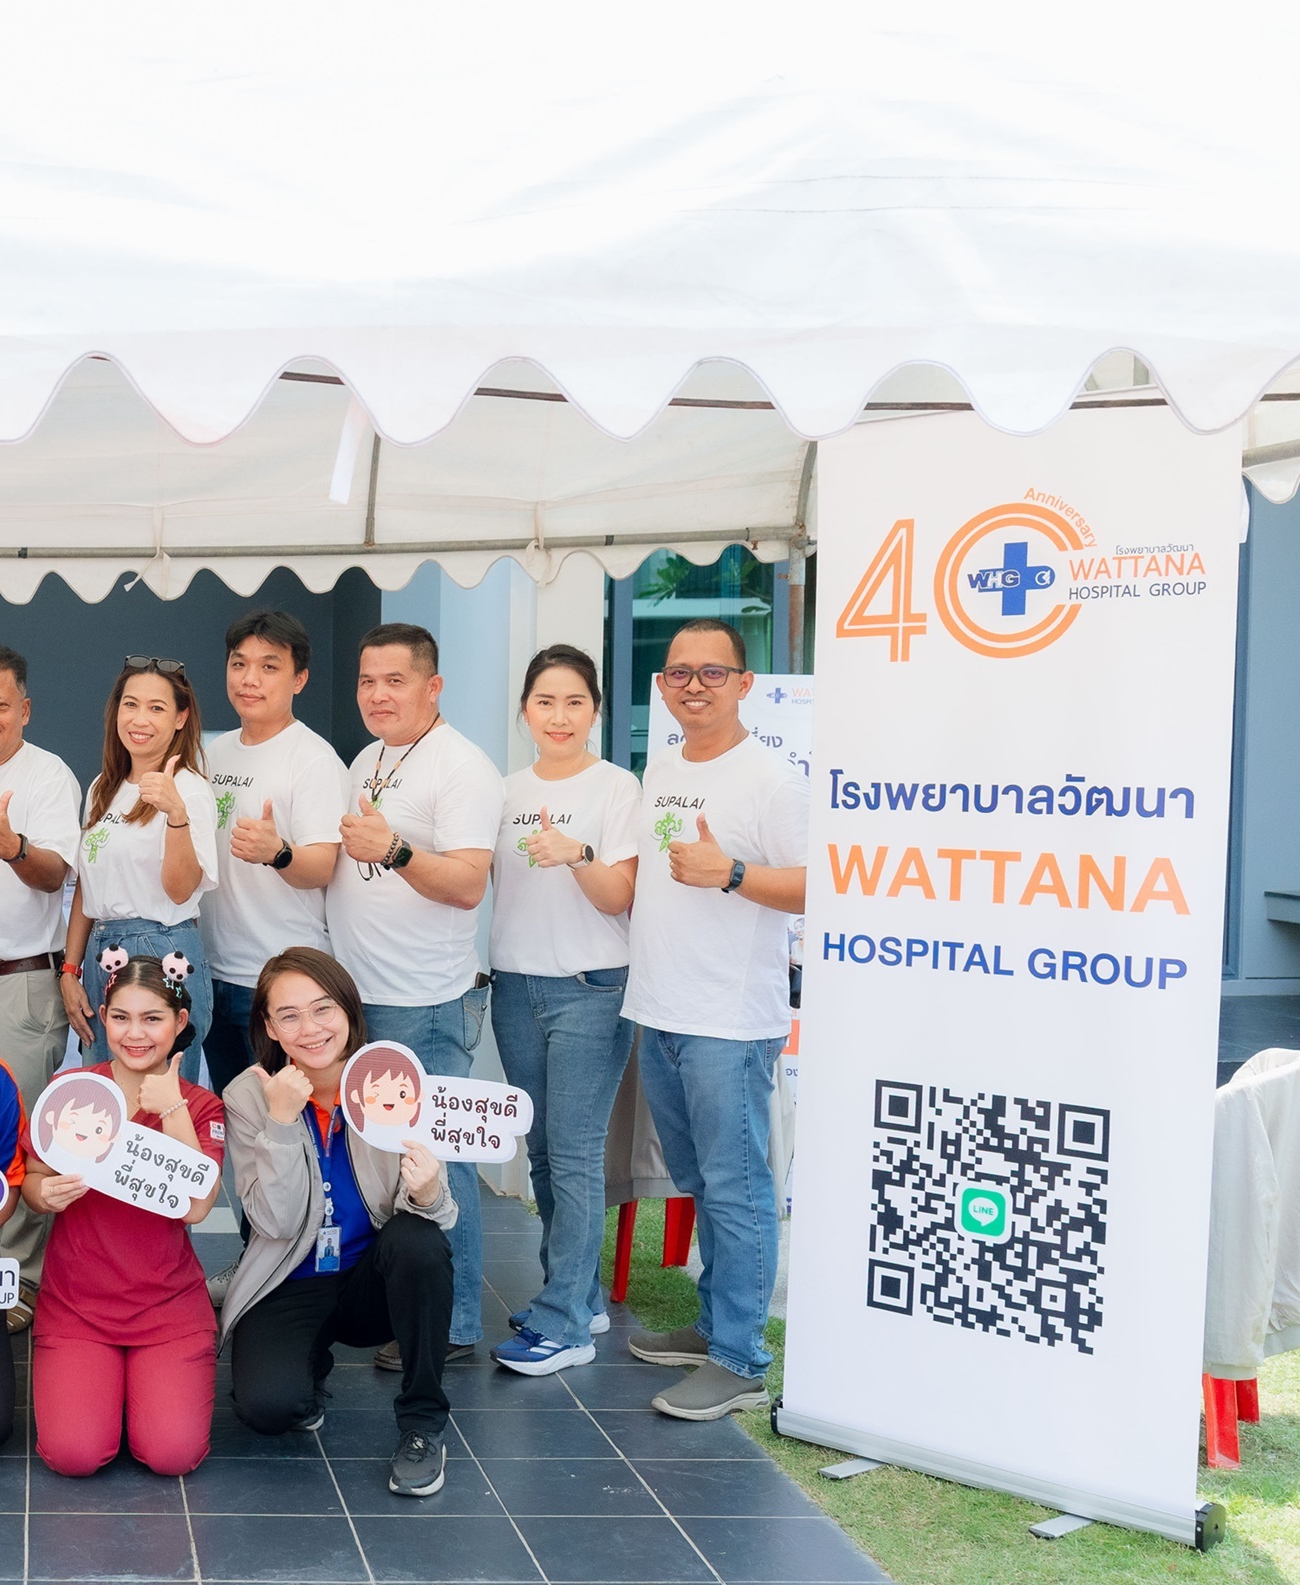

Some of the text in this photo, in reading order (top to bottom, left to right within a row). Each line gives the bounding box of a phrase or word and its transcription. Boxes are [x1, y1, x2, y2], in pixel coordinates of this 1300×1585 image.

[1023, 486, 1098, 548] Anniversary
[1068, 552, 1206, 582] WATTANA
[1115, 543, 1194, 556] โรงพยาบาลวัฒนา
[835, 502, 1085, 663] 40
[967, 569, 1021, 590] WHG
[1068, 581, 1207, 600] HOSPITAL GROUP
[211, 773, 254, 788] SUPALAI
[829, 769, 1196, 819] โรงพยาบาลวัฒนา
[512, 813, 572, 826] SUPLAI
[654, 796, 706, 810] SUPALAI
[827, 843, 1191, 916] WATTANA
[822, 932, 1188, 990] HOSPITAL GROUP
[431, 1086, 518, 1123] น้องสุขดี
[430, 1112, 501, 1153] พี่สุขใจ
[126, 1134, 209, 1186] น้องสุขดี
[114, 1160, 179, 1209] พี่สุขใจ
[973, 1204, 994, 1216] LINE
